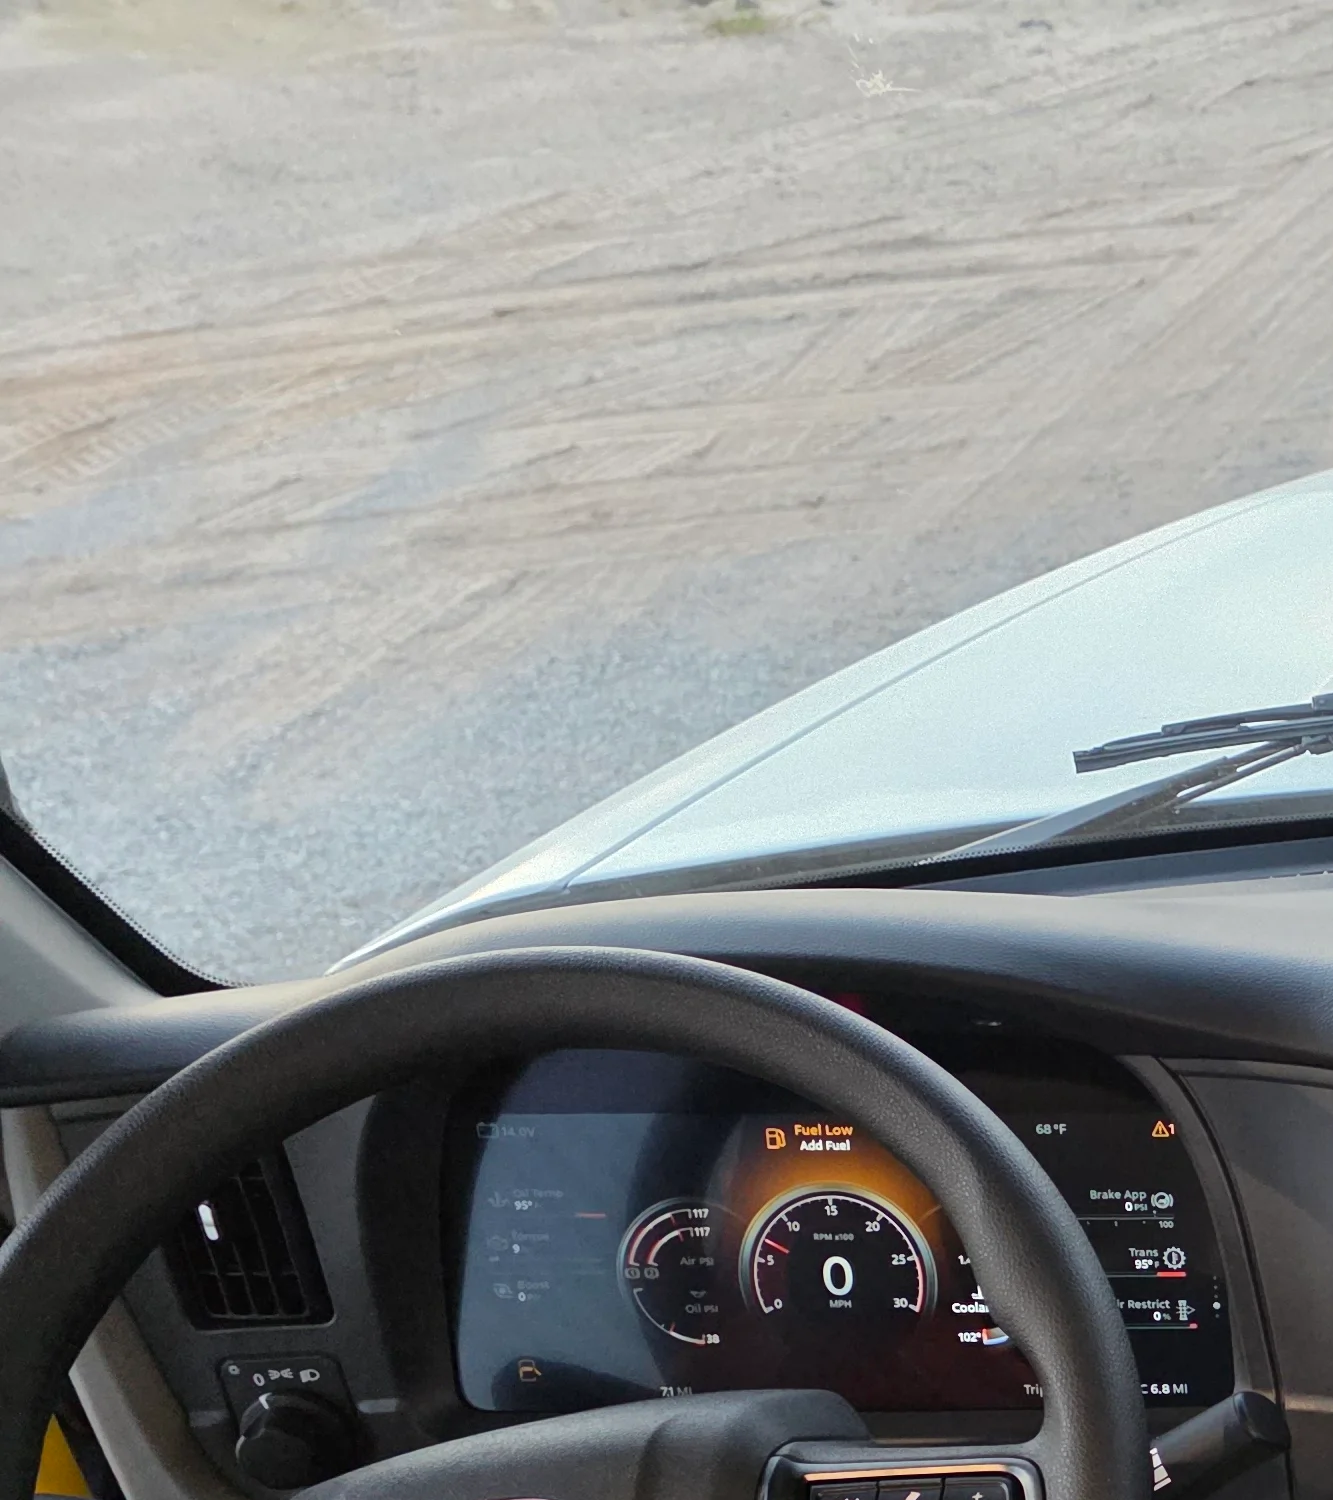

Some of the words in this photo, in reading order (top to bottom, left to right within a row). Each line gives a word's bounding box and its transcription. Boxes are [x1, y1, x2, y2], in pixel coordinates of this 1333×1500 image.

[794, 1124, 822, 1136] Fuel
[825, 1124, 853, 1136] Low
[1035, 1124, 1052, 1135] 68
[1168, 1124, 1175, 1135] 1
[800, 1139, 823, 1151] Add
[826, 1139, 850, 1151] Fuel
[1090, 1190, 1121, 1200] Brake
[1124, 1190, 1147, 1203] App
[825, 1205, 838, 1216] 15
[1124, 1201, 1133, 1212] 0
[1134, 1203, 1148, 1211] PSI
[692, 1209, 708, 1218] 117
[787, 1221, 800, 1231] 10
[865, 1221, 880, 1231] 20
[1159, 1221, 1174, 1229] 100
[694, 1227, 710, 1237] 117
[813, 1233, 832, 1241] RPM
[512, 1243, 521, 1255] 9
[1129, 1248, 1159, 1258] Trans
[680, 1257, 695, 1266] Air
[767, 1255, 775, 1265] 5
[891, 1254, 907, 1265] 25
[1135, 1259, 1153, 1270] 95°
[822, 1256, 853, 1296] 0
[518, 1291, 526, 1302] 0
[685, 1304, 701, 1313] Oil
[704, 1304, 719, 1313] PSI
[774, 1299, 783, 1309] 0
[829, 1299, 852, 1309] MPH
[893, 1297, 908, 1309] 30
[951, 1302, 990, 1314] Coola
[1127, 1299, 1171, 1310] Restrict
[1153, 1311, 1162, 1321] 0
[706, 1333, 720, 1344] 38
[957, 1332, 982, 1344] 102°
[677, 1386, 693, 1397] MI
[1150, 1384, 1170, 1395] 6.8
[1172, 1383, 1188, 1394] MI
